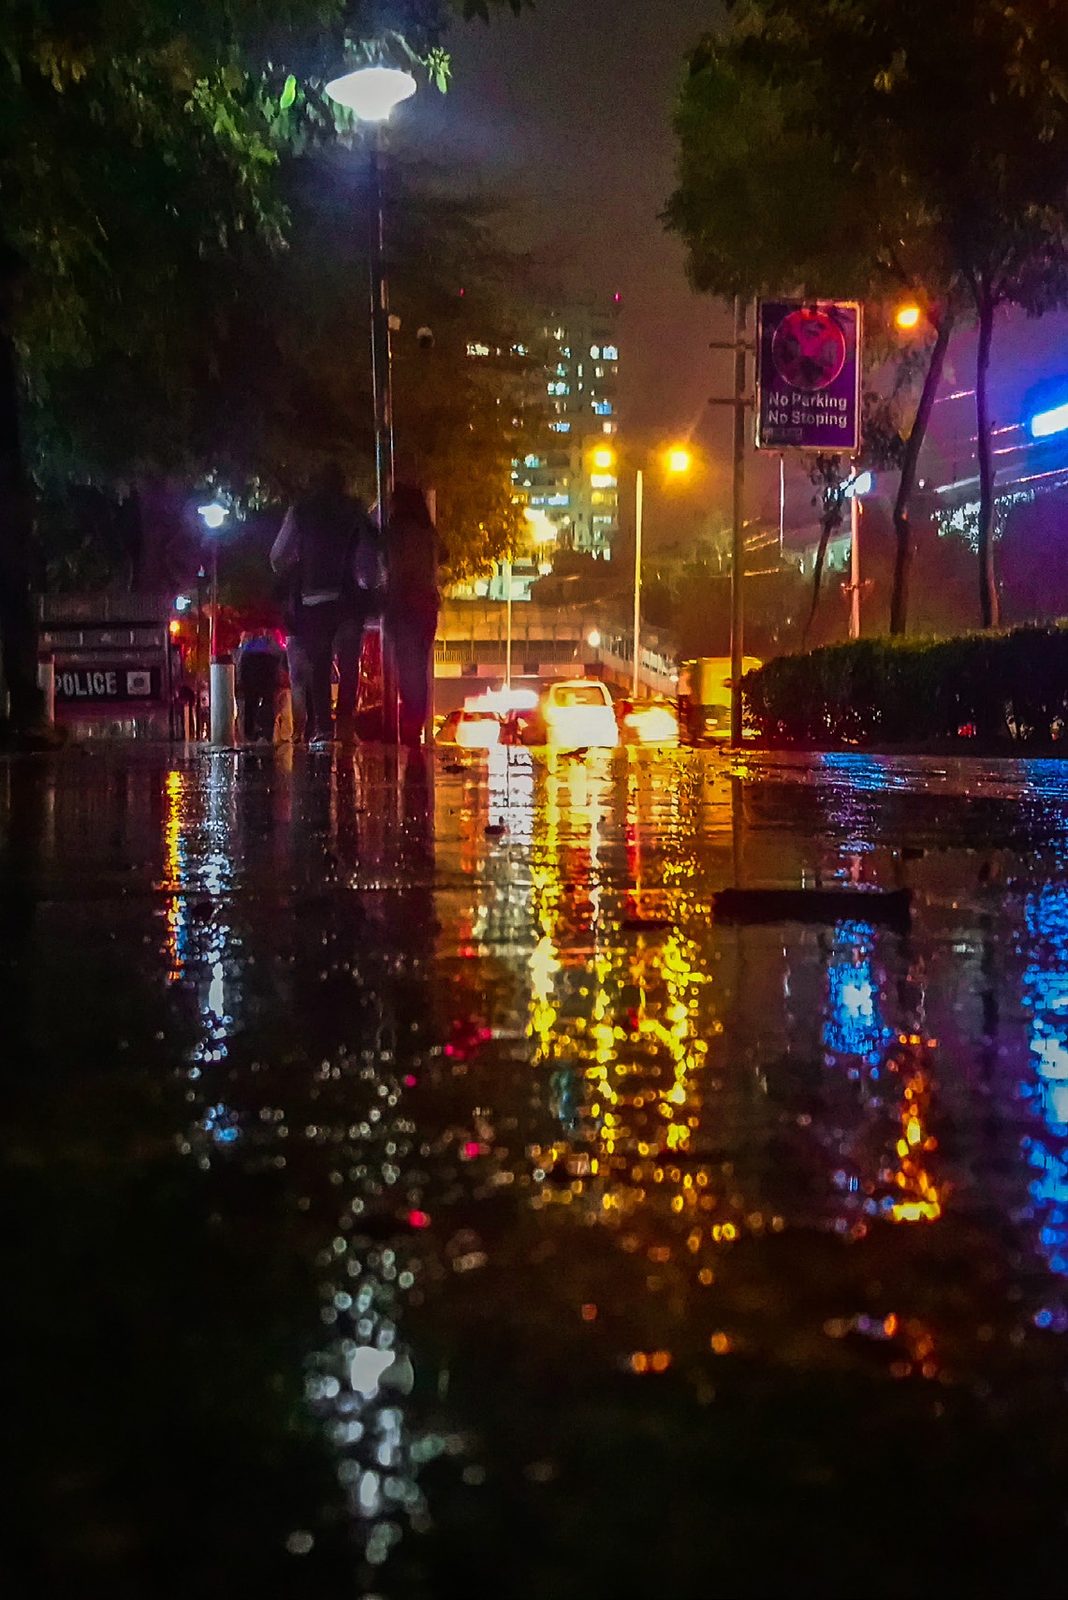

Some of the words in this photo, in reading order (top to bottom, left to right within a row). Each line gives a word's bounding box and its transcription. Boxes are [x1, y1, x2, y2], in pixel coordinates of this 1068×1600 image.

[769, 391, 788, 406] No
[792, 392, 847, 411] Parking
[768, 410, 788, 424] No
[792, 411, 847, 428] Stoping
